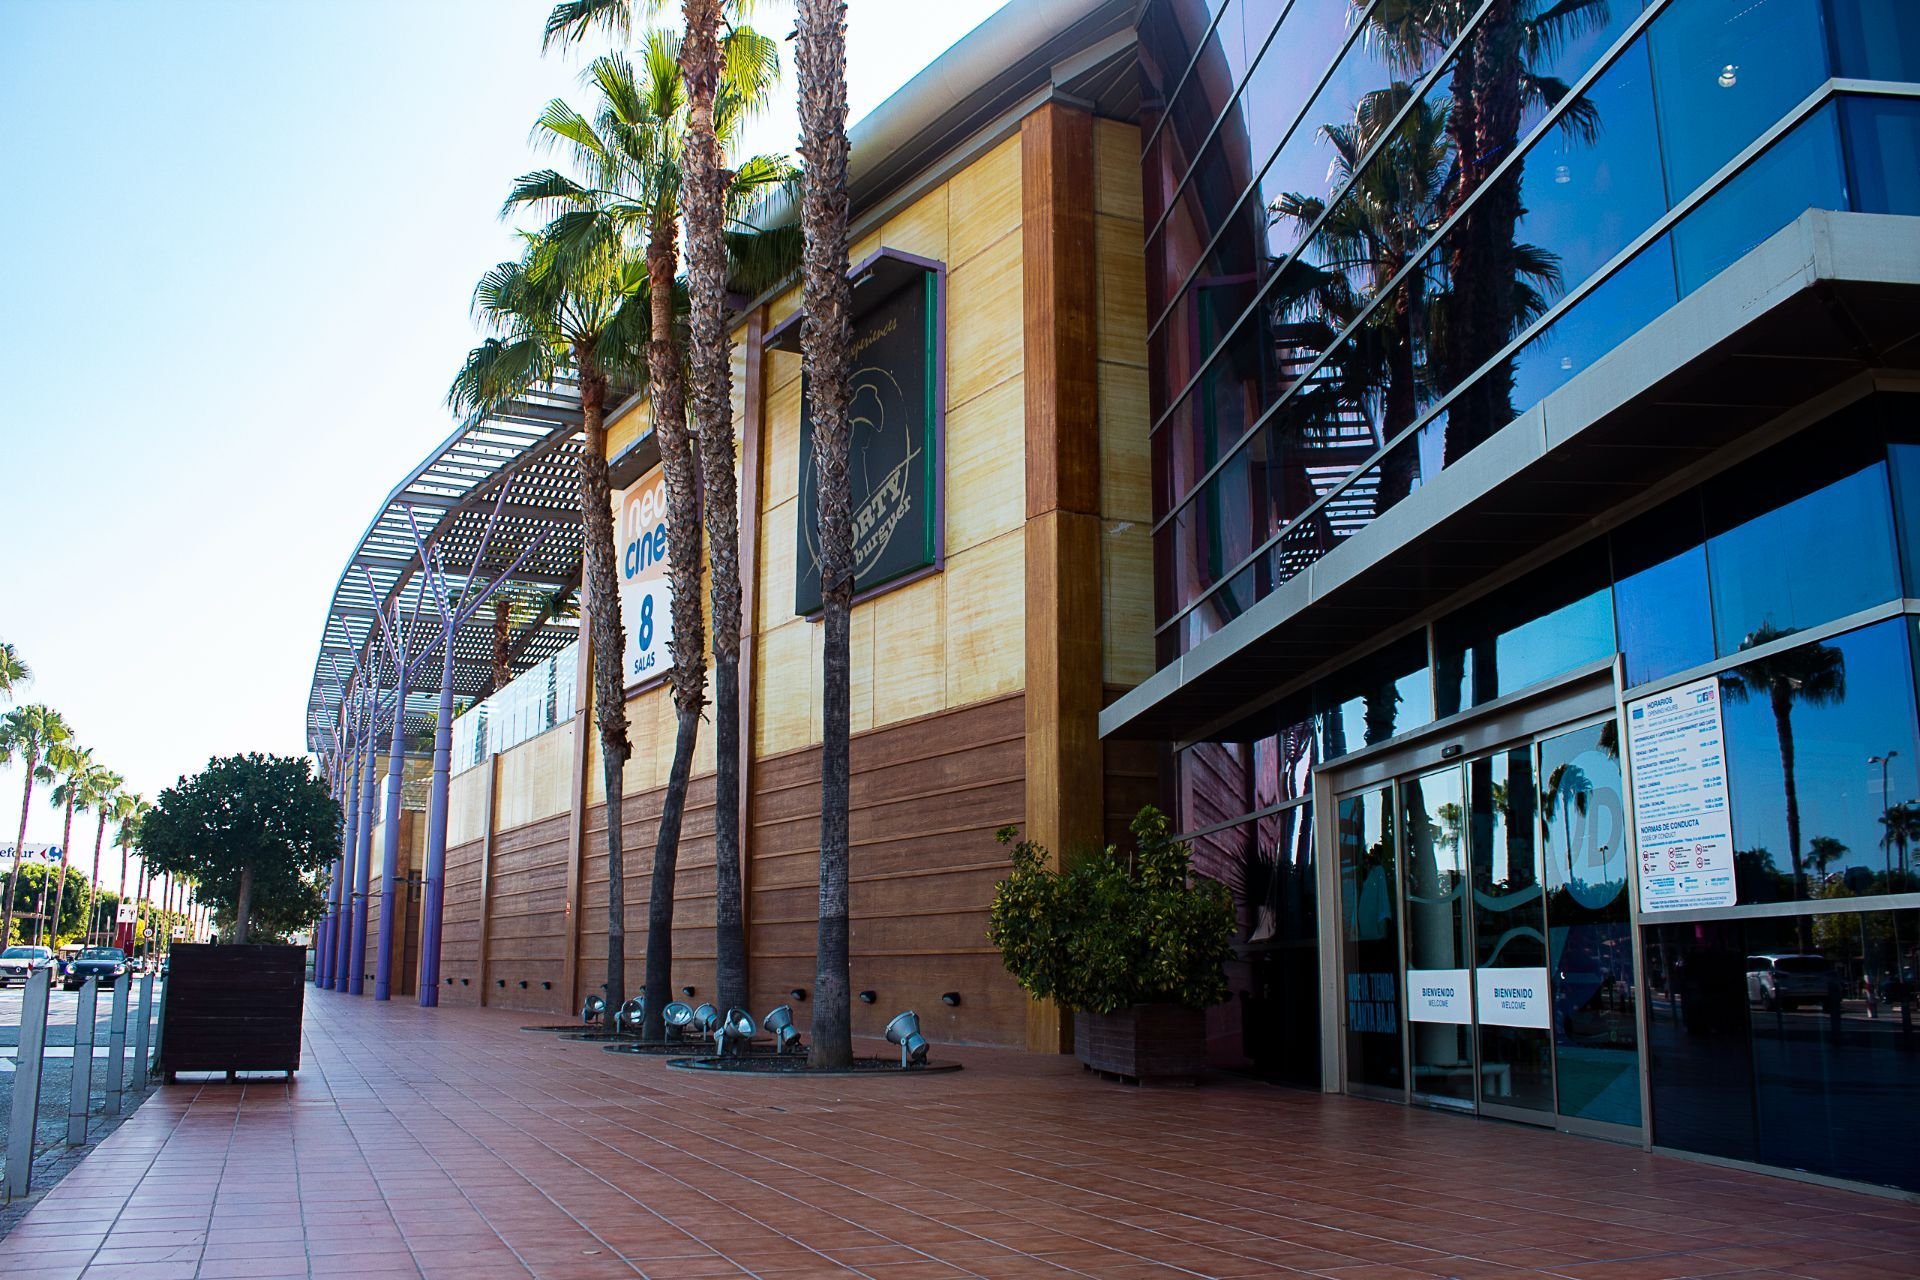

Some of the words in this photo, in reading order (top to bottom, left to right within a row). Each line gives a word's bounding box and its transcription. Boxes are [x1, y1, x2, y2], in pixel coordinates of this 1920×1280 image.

[628, 479, 667, 538] neo
[853, 494, 911, 566] burguer
[625, 522, 666, 580] cine
[638, 593, 654, 651] 8
[634, 651, 655, 675] SALAS
[1647, 696, 1673, 709] HORARIOS
[1641, 823, 1662, 834] NORMAS
[1662, 822, 1670, 831] DE
[1670, 818, 1700, 830] CONDUCTA
[1421, 987, 1455, 998] BIENVENIDO
[1494, 987, 1533, 999] BIENVENIDO
[1428, 999, 1449, 1008] WELCOME
[1501, 1000, 1526, 1010] WELCOME
